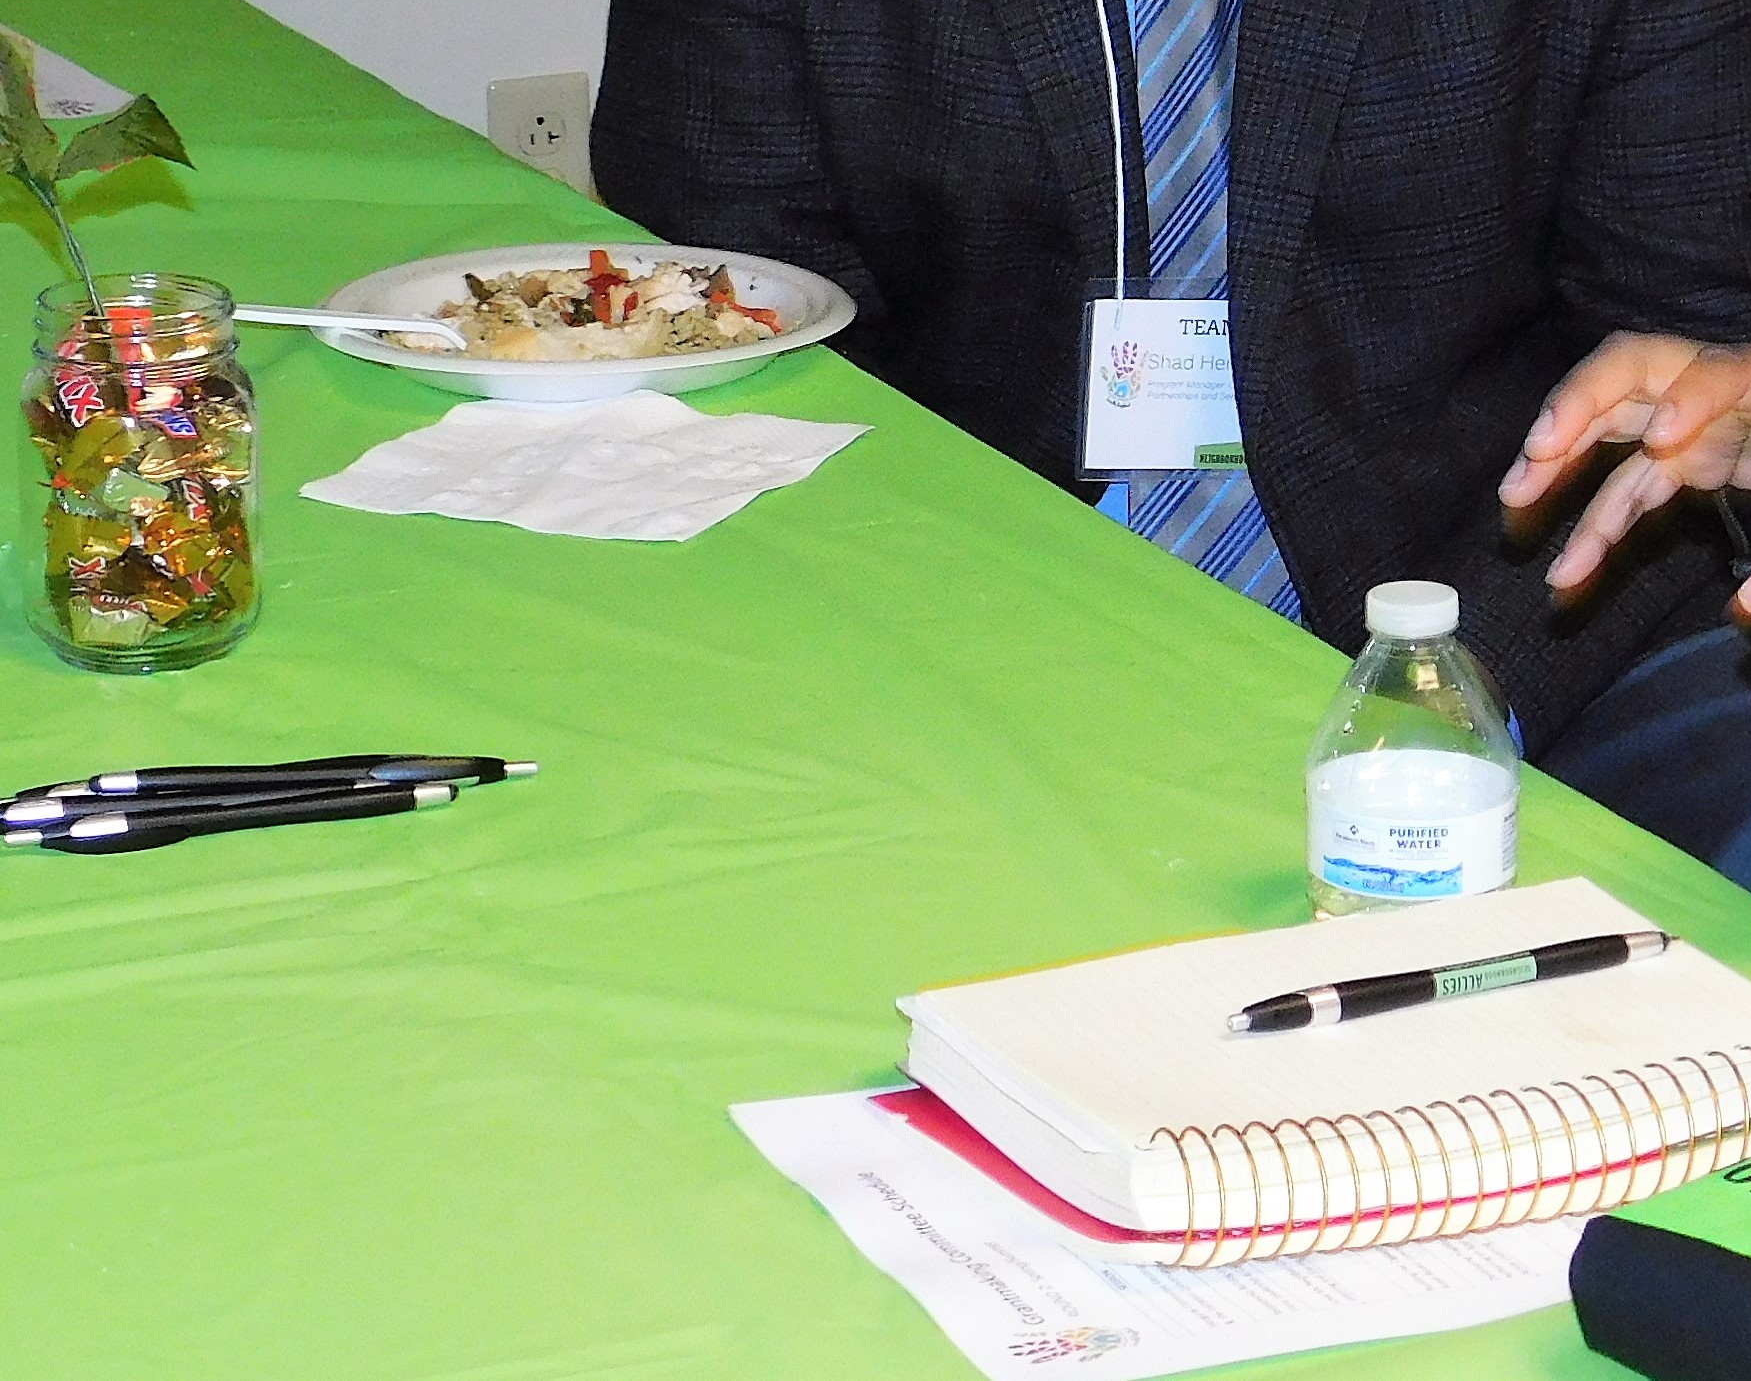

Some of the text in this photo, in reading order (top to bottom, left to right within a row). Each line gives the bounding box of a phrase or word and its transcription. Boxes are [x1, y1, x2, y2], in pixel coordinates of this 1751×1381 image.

[1148, 353, 1194, 371] Shad
[1389, 828, 1449, 838] PURIFIED
[1396, 839, 1442, 849] WATER
[1442, 973, 1483, 996] ALLIES
[857, 1171, 1045, 1325] Grantmaking Committee Schedule
